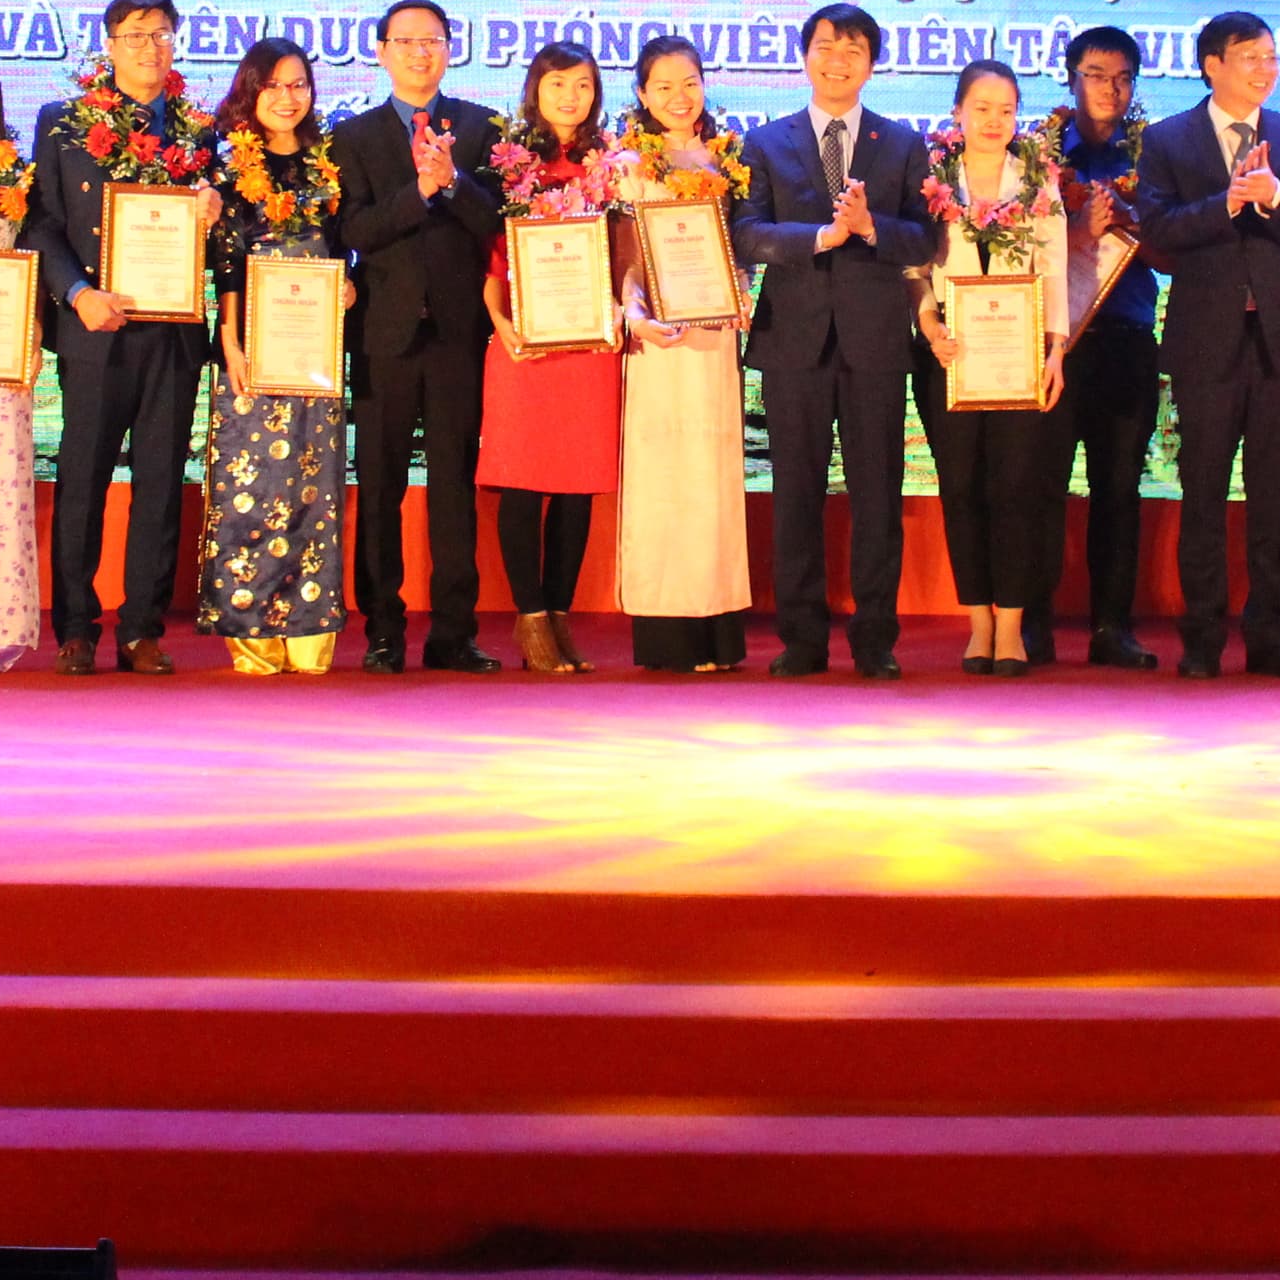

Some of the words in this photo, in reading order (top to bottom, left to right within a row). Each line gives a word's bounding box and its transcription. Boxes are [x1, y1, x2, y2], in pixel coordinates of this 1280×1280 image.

[77, 5, 260, 56] TÊN
[1007, 19, 1072, 79] TẬ
[1133, 28, 1200, 72] VI
